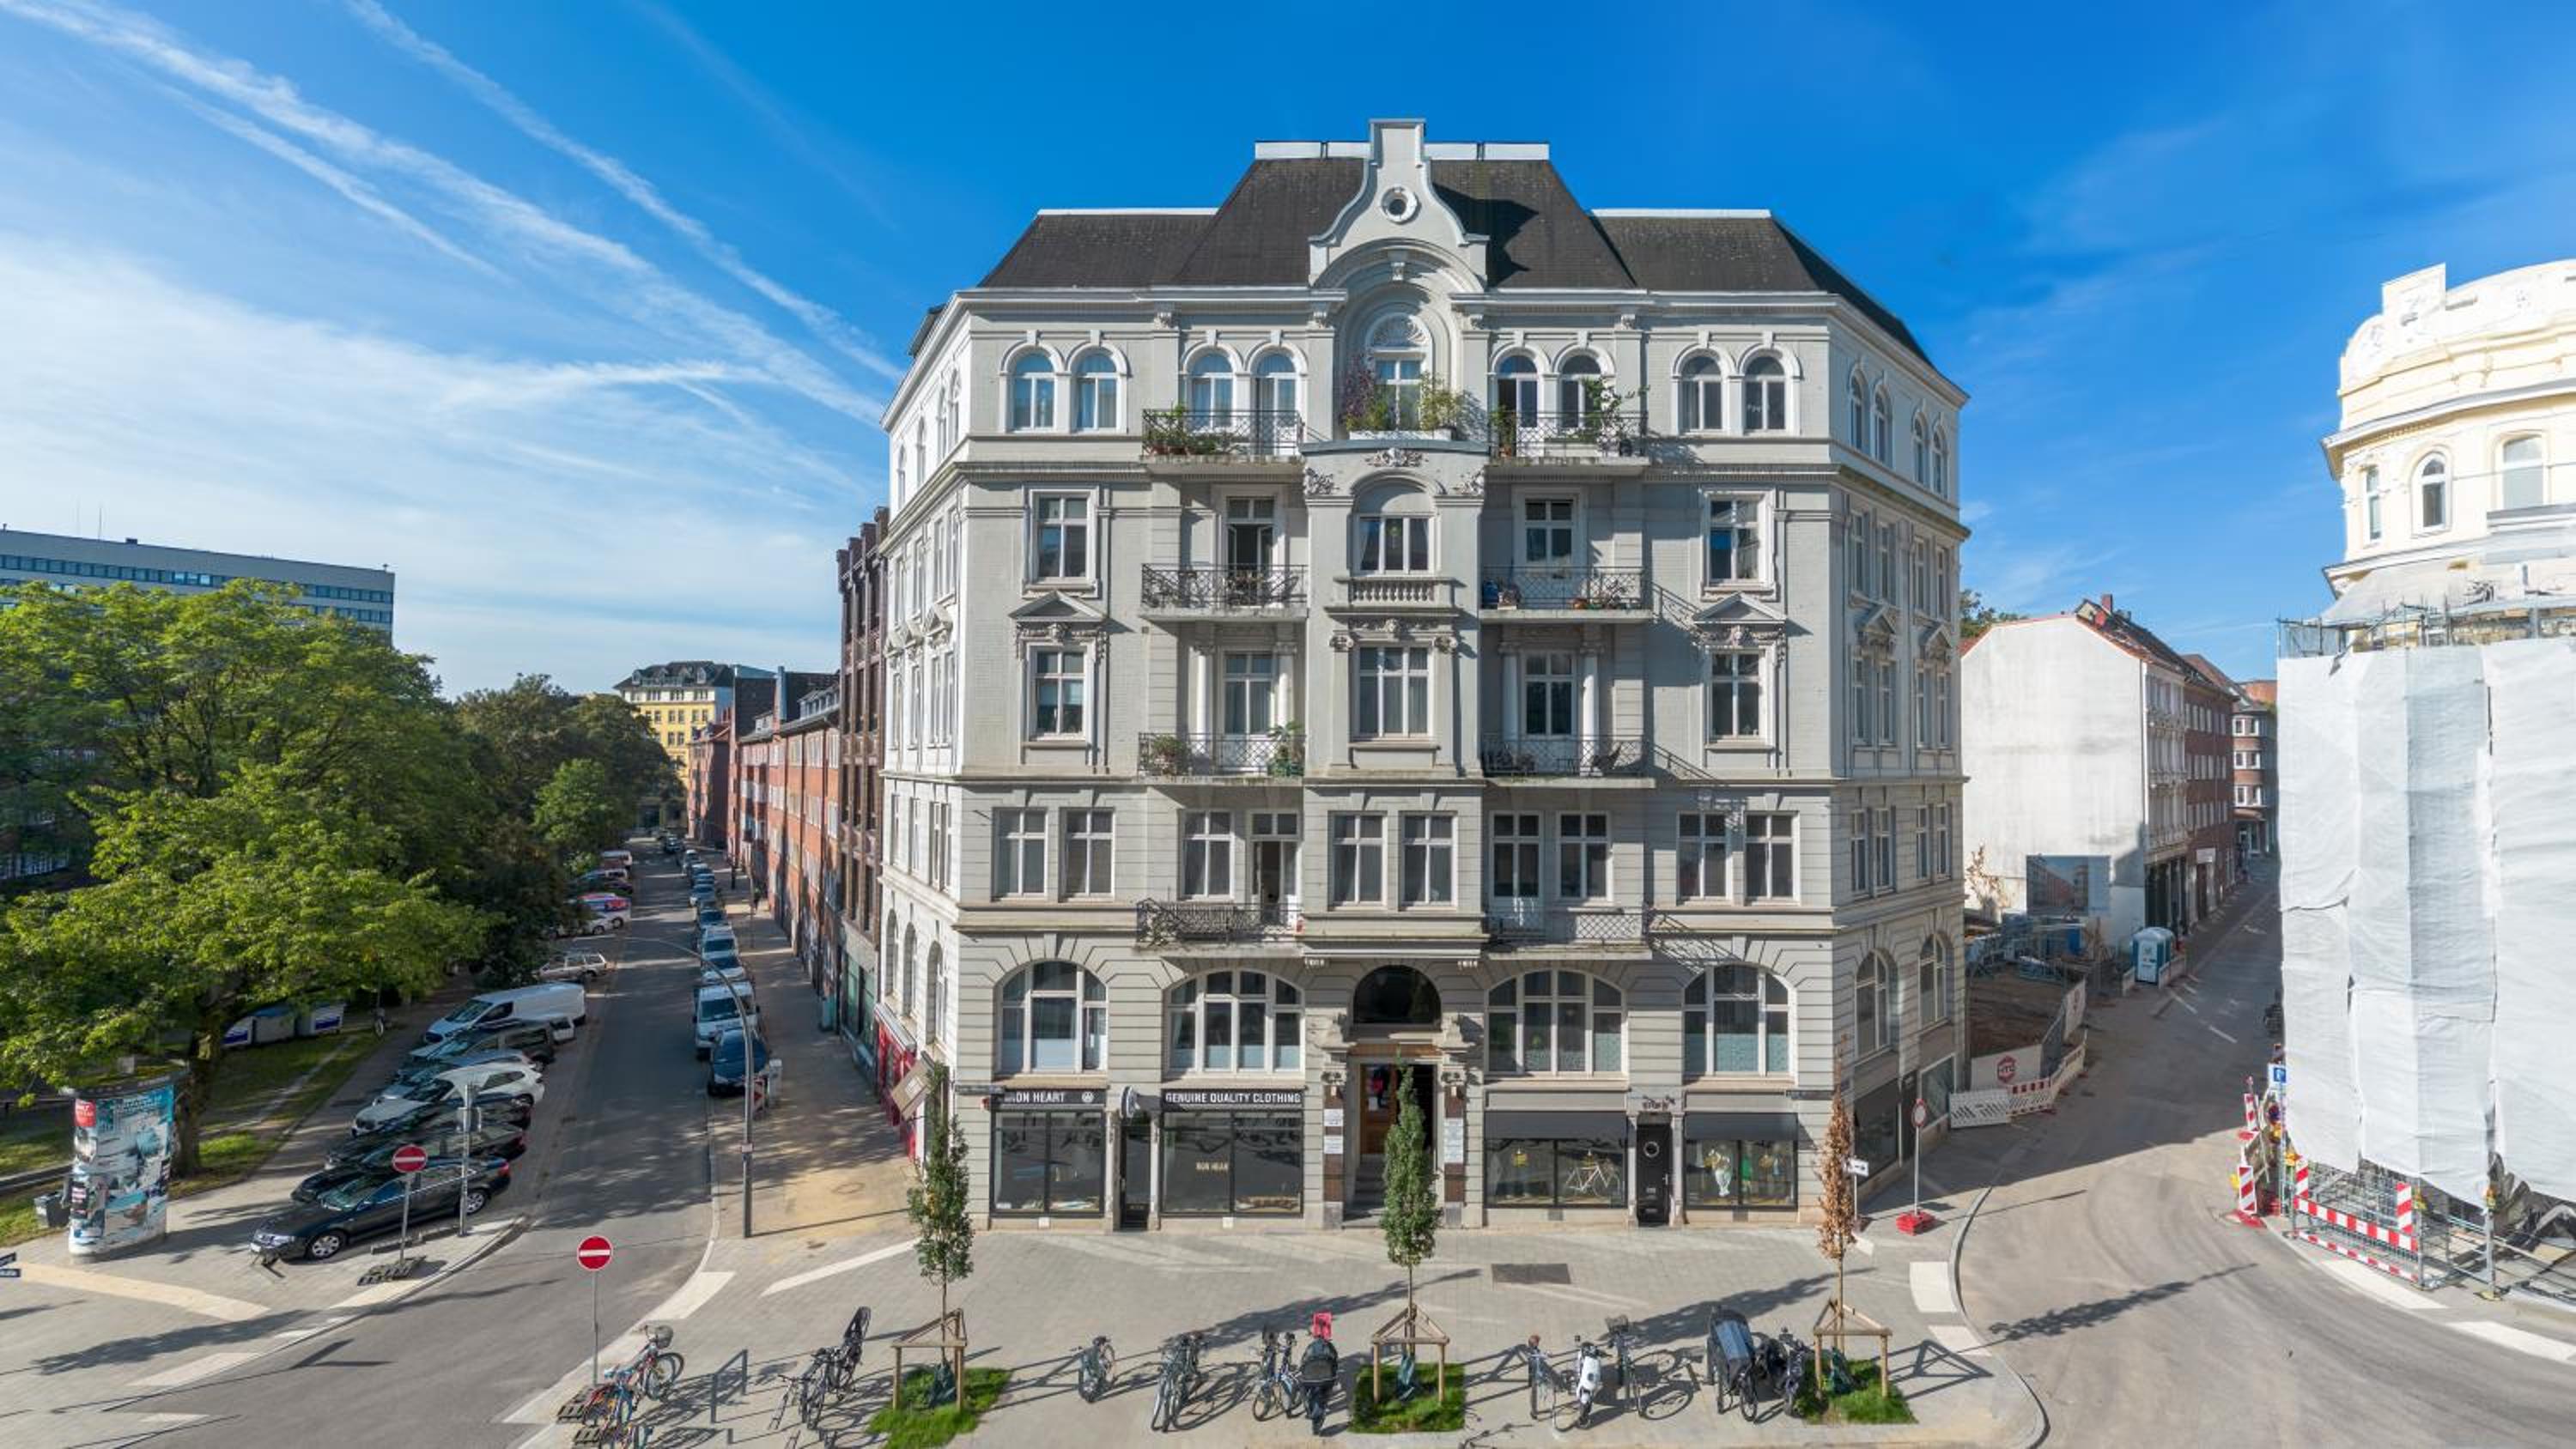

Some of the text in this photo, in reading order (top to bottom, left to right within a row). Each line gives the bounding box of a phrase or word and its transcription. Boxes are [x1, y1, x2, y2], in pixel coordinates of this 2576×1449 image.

[1033, 1091, 1065, 1103] HEART
[1165, 1093, 1301, 1103] GENUINE QUALITY CLOTHING
